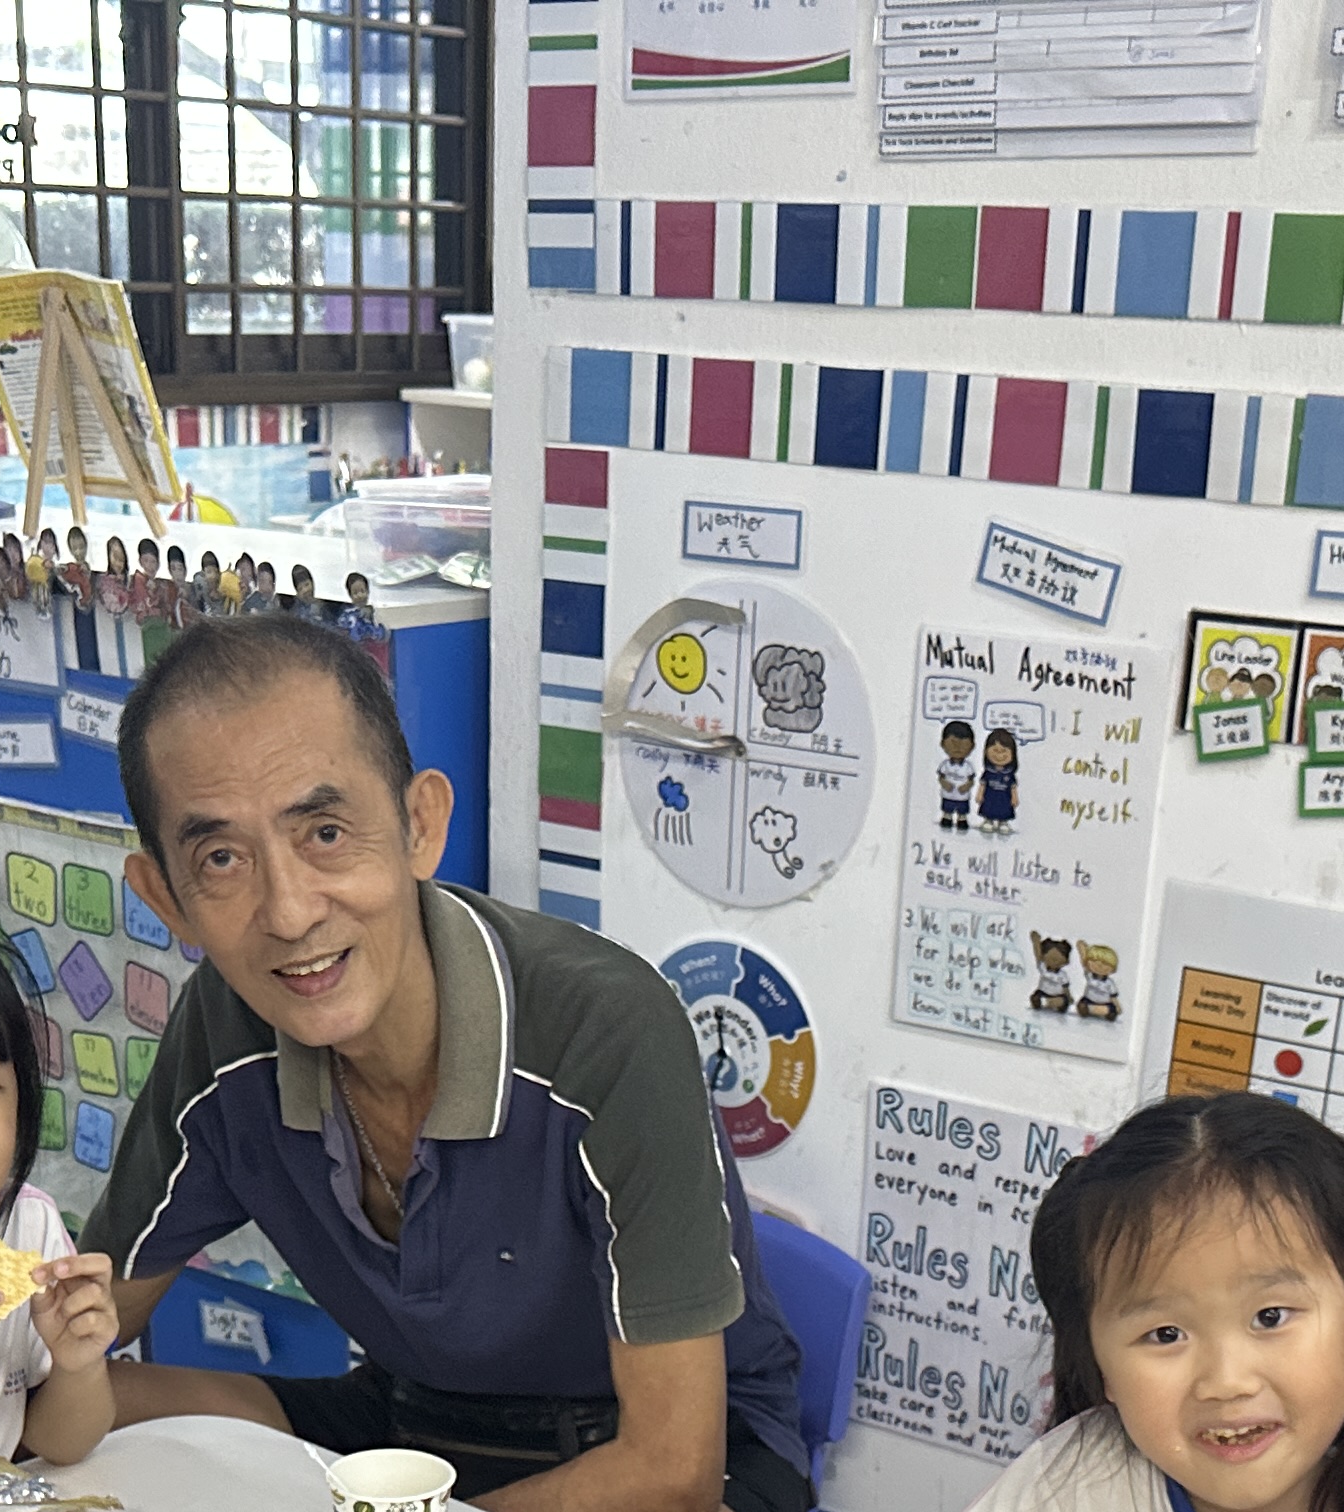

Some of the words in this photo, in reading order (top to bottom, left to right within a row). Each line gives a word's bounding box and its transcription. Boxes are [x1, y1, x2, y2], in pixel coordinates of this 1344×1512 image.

[697, 511, 766, 532] Weather
[925, 633, 994, 675] Mutual
[1018, 646, 1136, 701] Agreement
[1105, 716, 1143, 744] will
[1063, 752, 1129, 785] control
[24, 859, 40, 883] 2
[76, 869, 90, 891] 3
[926, 868, 963, 892] each
[968, 850, 999, 877] will
[1012, 848, 1060, 884] listen
[1074, 859, 1092, 887] to
[13, 886, 48, 918] two
[986, 916, 1015, 943] ask
[916, 937, 939, 960] for
[948, 942, 981, 980] help
[875, 1087, 1002, 1162] Rules
[875, 1141, 917, 1166] Love
[938, 1162, 977, 1181] and
[874, 1171, 958, 1206] everyone
[977, 1194, 993, 1216] in
[867, 1212, 969, 1290] Rules
[870, 1275, 919, 1300] isten
[947, 1298, 979, 1316] and
[871, 1301, 989, 1346] instructions.
[856, 1320, 966, 1411] Rules
[856, 1403, 933, 1436] classroom
[946, 1431, 976, 1447] and
[899, 1397, 935, 1418] care
[947, 1410, 968, 1429] of
[978, 1424, 1011, 1439] our
